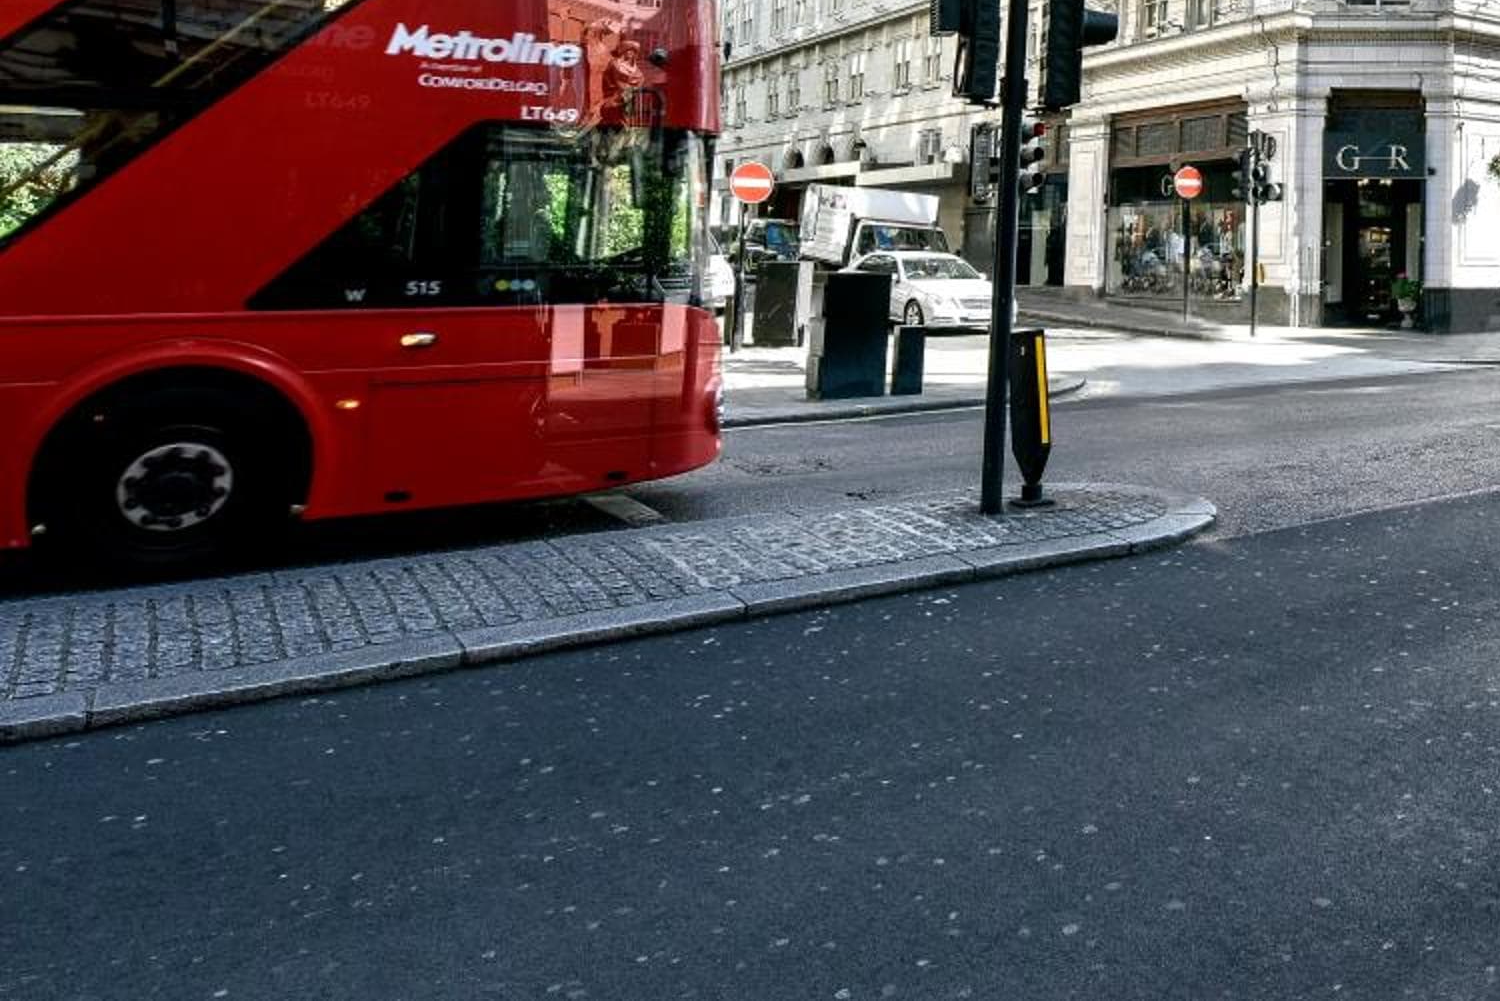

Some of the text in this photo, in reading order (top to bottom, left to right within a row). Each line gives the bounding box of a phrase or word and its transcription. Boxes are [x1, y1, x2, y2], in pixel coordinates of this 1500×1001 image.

[385, 23, 582, 67] Metroline
[520, 105, 579, 122] LT649
[405, 280, 442, 295] 515
